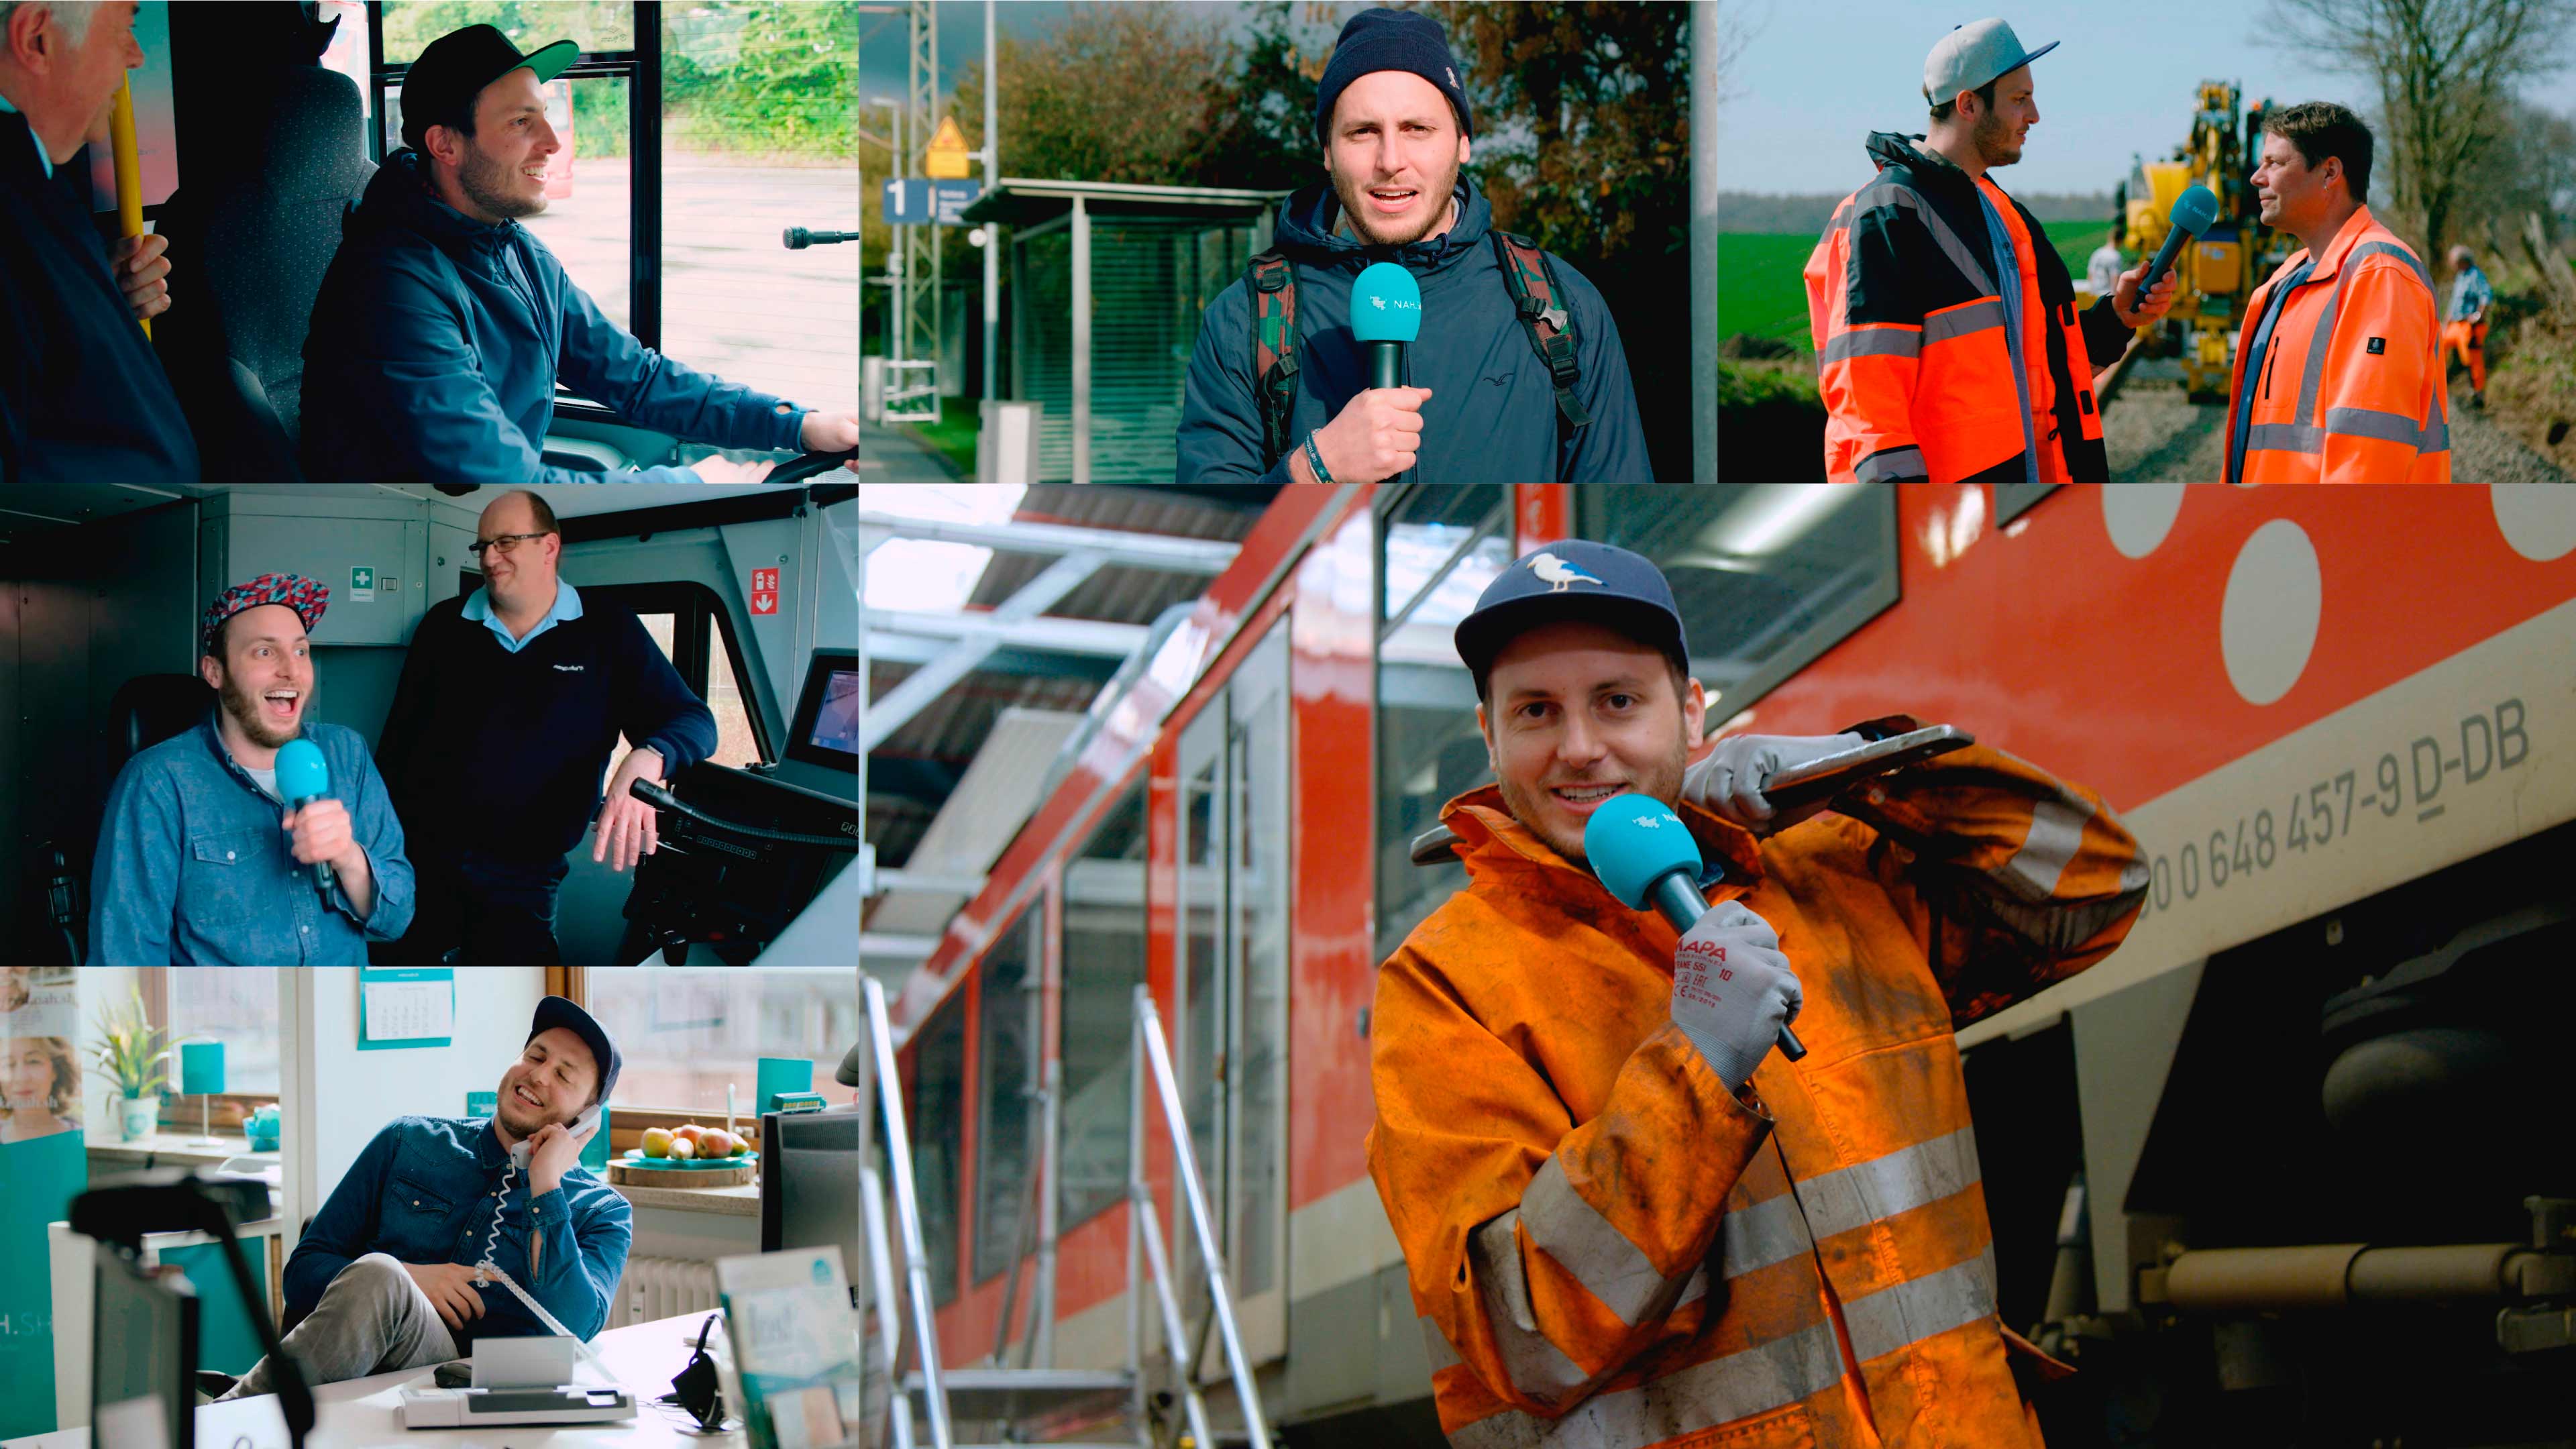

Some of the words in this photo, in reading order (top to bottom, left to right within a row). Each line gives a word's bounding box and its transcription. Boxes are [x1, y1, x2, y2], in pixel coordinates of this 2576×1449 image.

[887, 179, 904, 216] 1
[2139, 857, 2171, 920] 0
[2209, 809, 2276, 889] 648
[2287, 753, 2402, 853] 457-9
[2412, 698, 2530, 812] D-DB
[1719, 969, 1733, 981] 10
